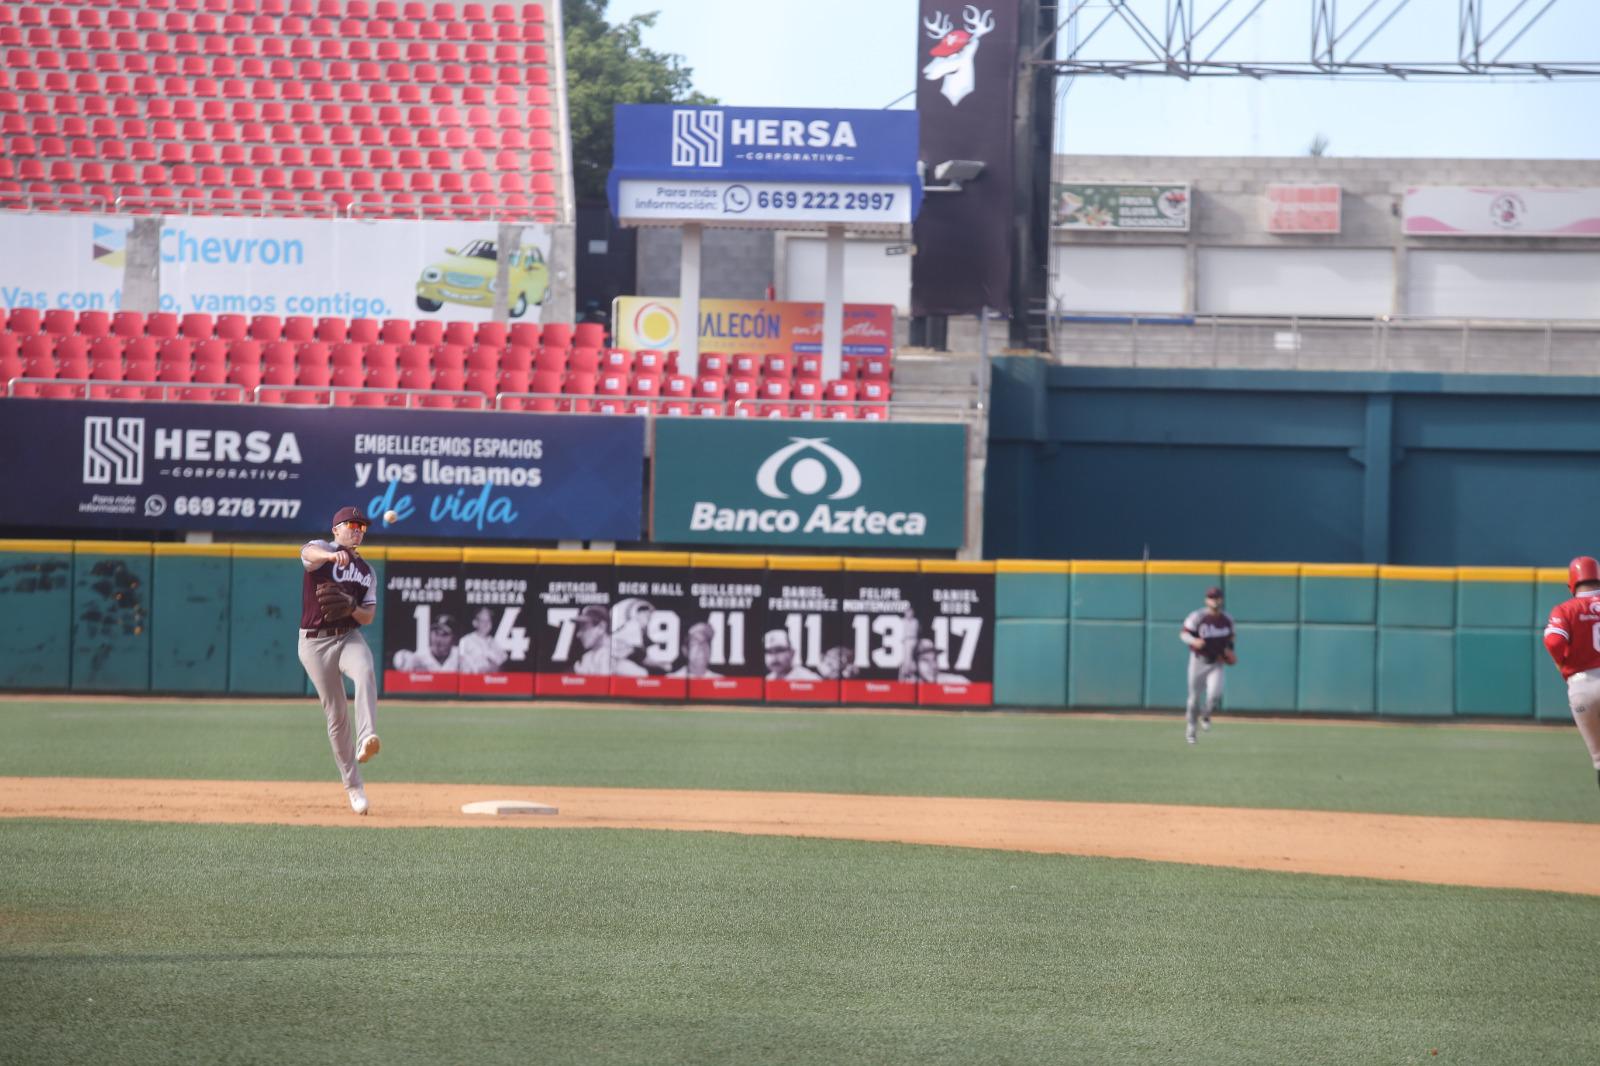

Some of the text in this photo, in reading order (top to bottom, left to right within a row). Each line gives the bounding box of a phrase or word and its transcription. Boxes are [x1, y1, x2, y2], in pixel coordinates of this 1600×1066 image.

[731, 119, 857, 148] HERSA
[745, 152, 845, 162] CORPORATIVO
[635, 198, 717, 210] información:
[657, 187, 717, 197] Para más
[757, 190, 894, 211] 669 222 2997
[159, 229, 304, 265] Chevron
[2, 286, 48, 310] Vas
[57, 291, 105, 310] con
[191, 294, 276, 313] vamos
[285, 294, 392, 319] contigo.
[698, 309, 781, 338] ALECÓN
[154, 428, 303, 464] HERSA
[354, 434, 543, 459] EMBELLECEMOS ESPACIOS
[172, 467, 288, 480] CORPORATIVO
[354, 457, 542, 488] y los llenamos
[92, 494, 136, 504] Para más
[173, 496, 302, 518] 669 278 7717
[367, 480, 519, 531] de vida
[690, 502, 927, 536] Banco Azteca
[387, 577, 422, 590] JUAN
[618, 581, 684, 596] DICK HALL
[691, 583, 762, 597] GUILLERMO
[782, 586, 825, 599] DANIEL
[859, 588, 901, 600] FELIPE
[933, 589, 980, 602] DANIEL
[413, 605, 431, 657] 1
[495, 607, 530, 661] 4
[547, 608, 580, 661] 7
[647, 610, 681, 662] 9
[708, 611, 745, 665] 11
[785, 614, 822, 667] 11
[852, 614, 904, 668] 13
[932, 616, 984, 670] 17
